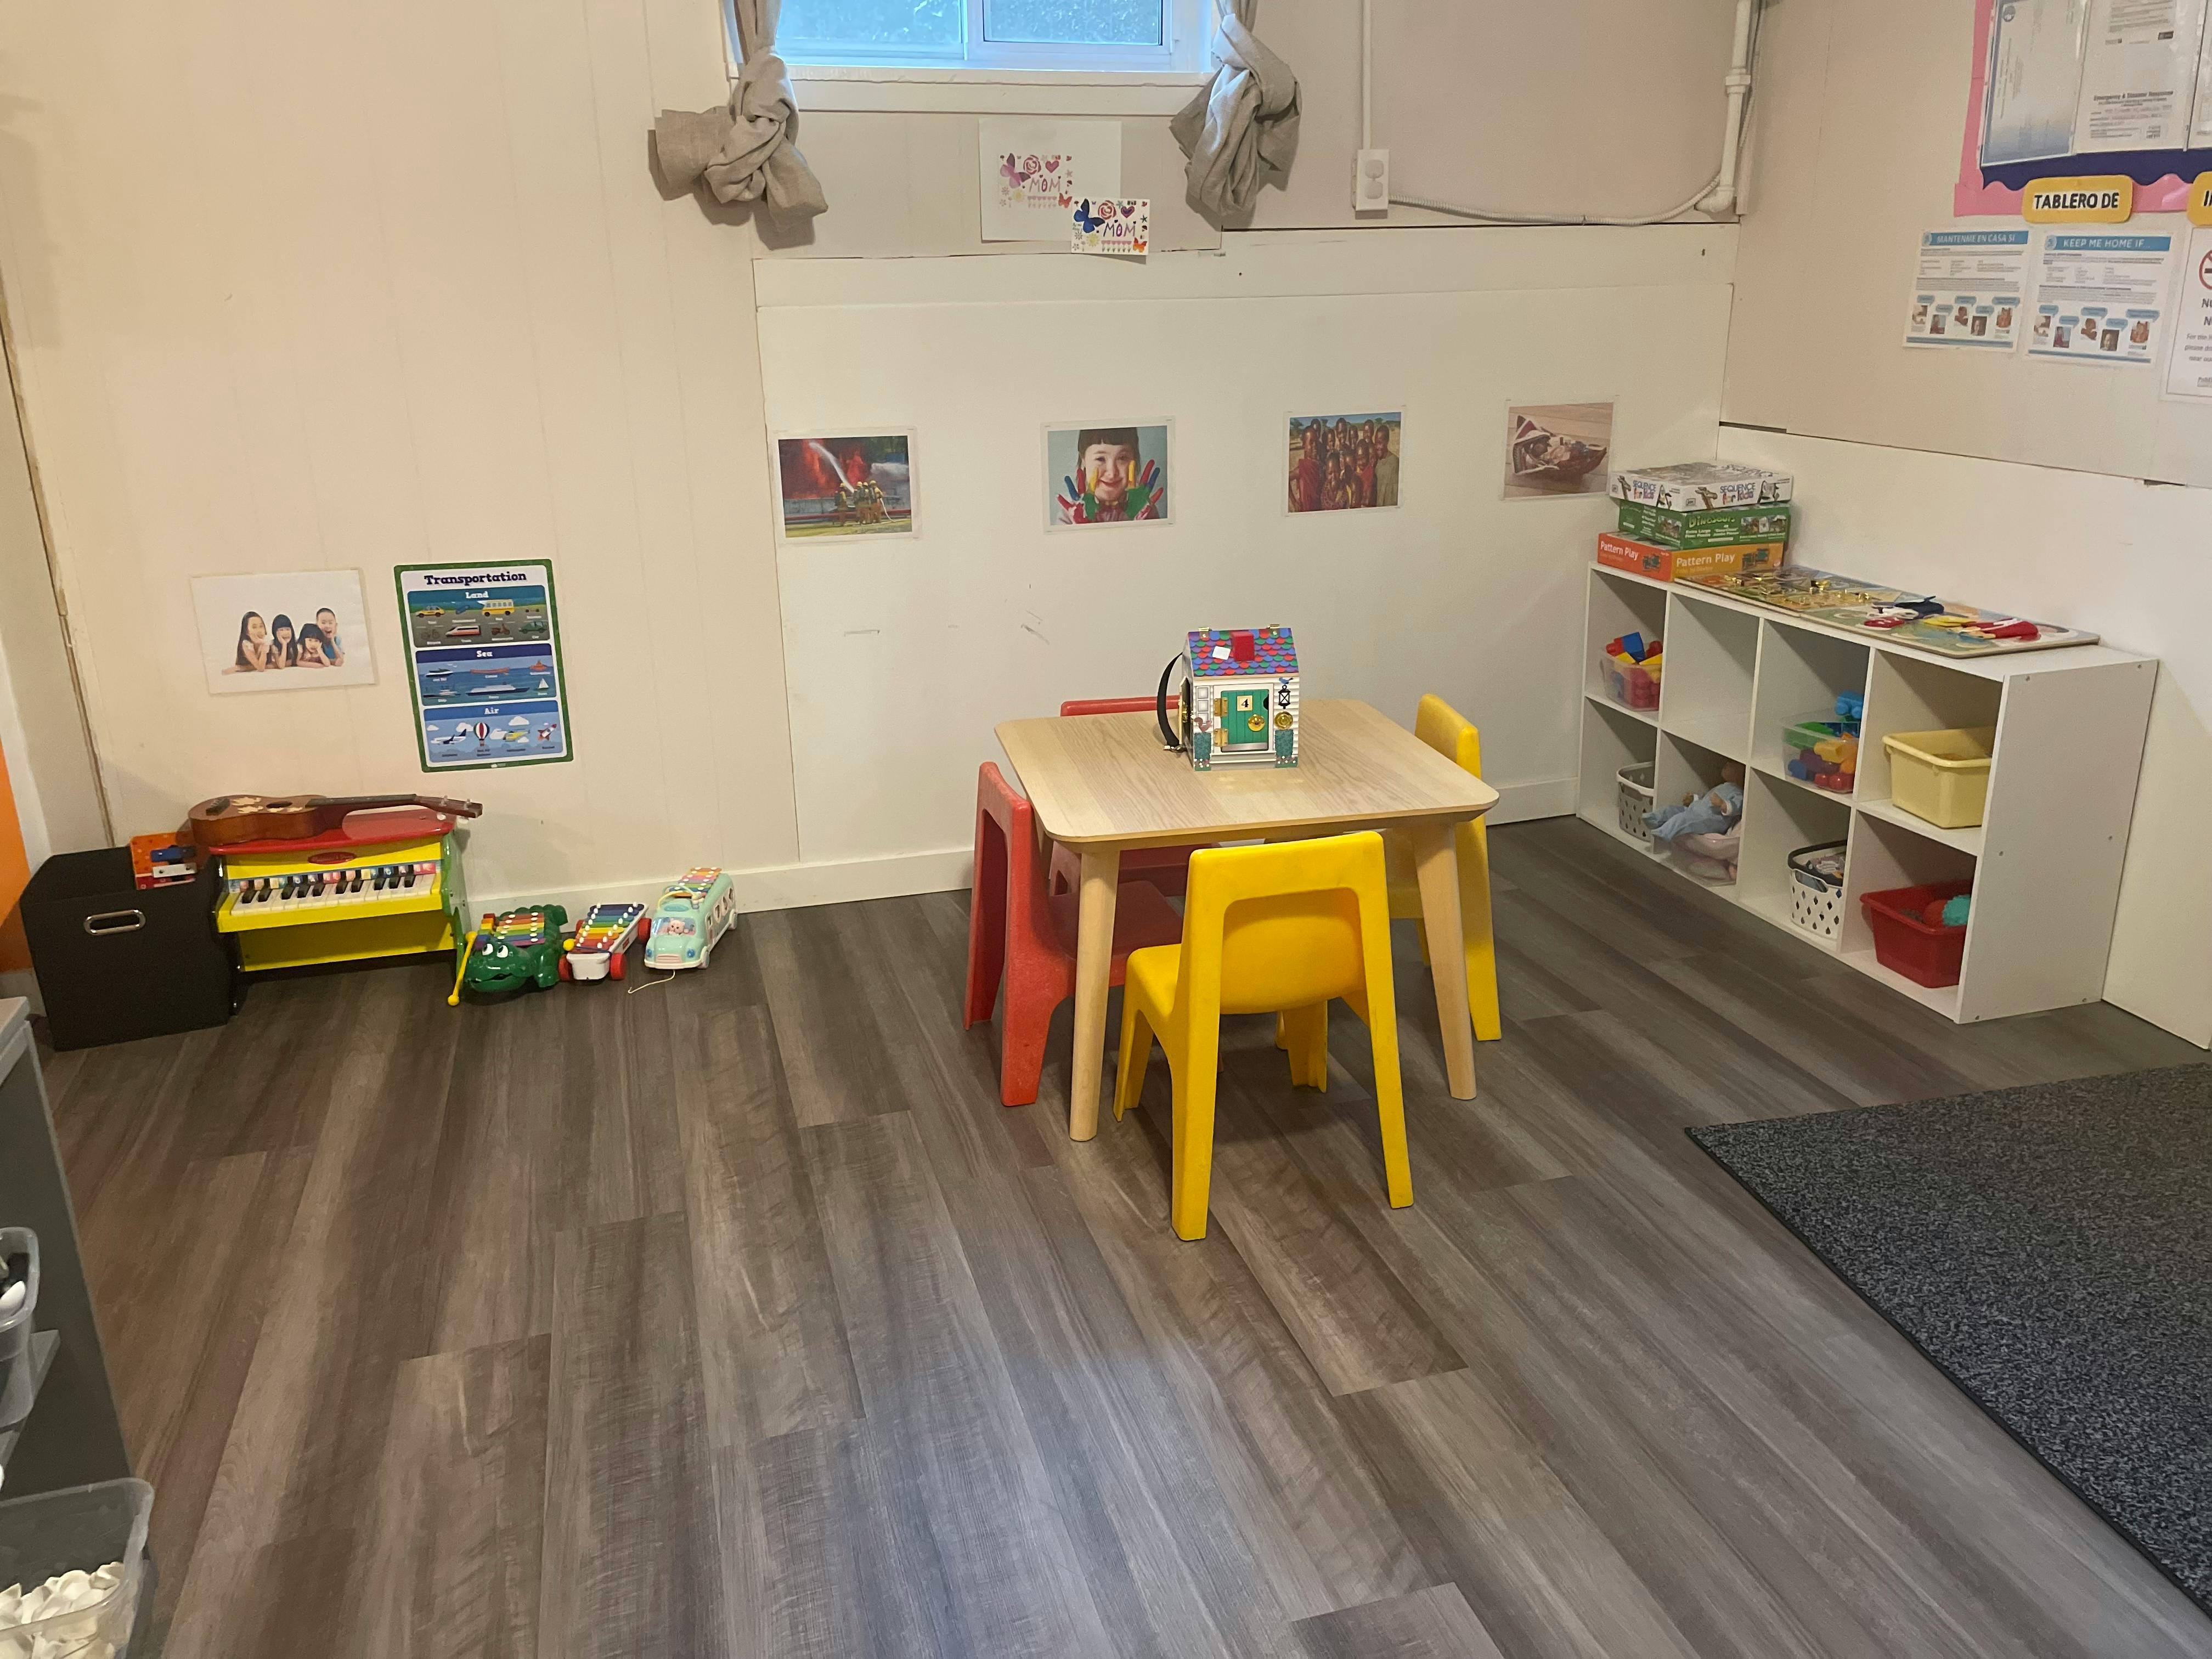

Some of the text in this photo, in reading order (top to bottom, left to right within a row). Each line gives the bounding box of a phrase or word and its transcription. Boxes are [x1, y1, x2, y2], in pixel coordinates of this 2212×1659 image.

[1029, 178, 1060, 192] MOM
[2034, 193, 2119, 209] TABLERO DE
[1103, 222, 1136, 237] MOM
[1988, 234, 2006, 242] CASA
[2008, 234, 2015, 242] SI
[2063, 238, 2086, 247] KEEP
[2105, 239, 2132, 247] HOME
[1633, 479, 1657, 492] SEQUENCE
[1720, 483, 1756, 493] SEQUENCE
[1600, 540, 1623, 556] Pattern
[1624, 547, 1639, 561] Play
[1676, 553, 1735, 567] Pattern Play
[424, 571, 527, 586] Transportation
[465, 591, 489, 599] Land
[1241, 698, 1249, 708] 4
